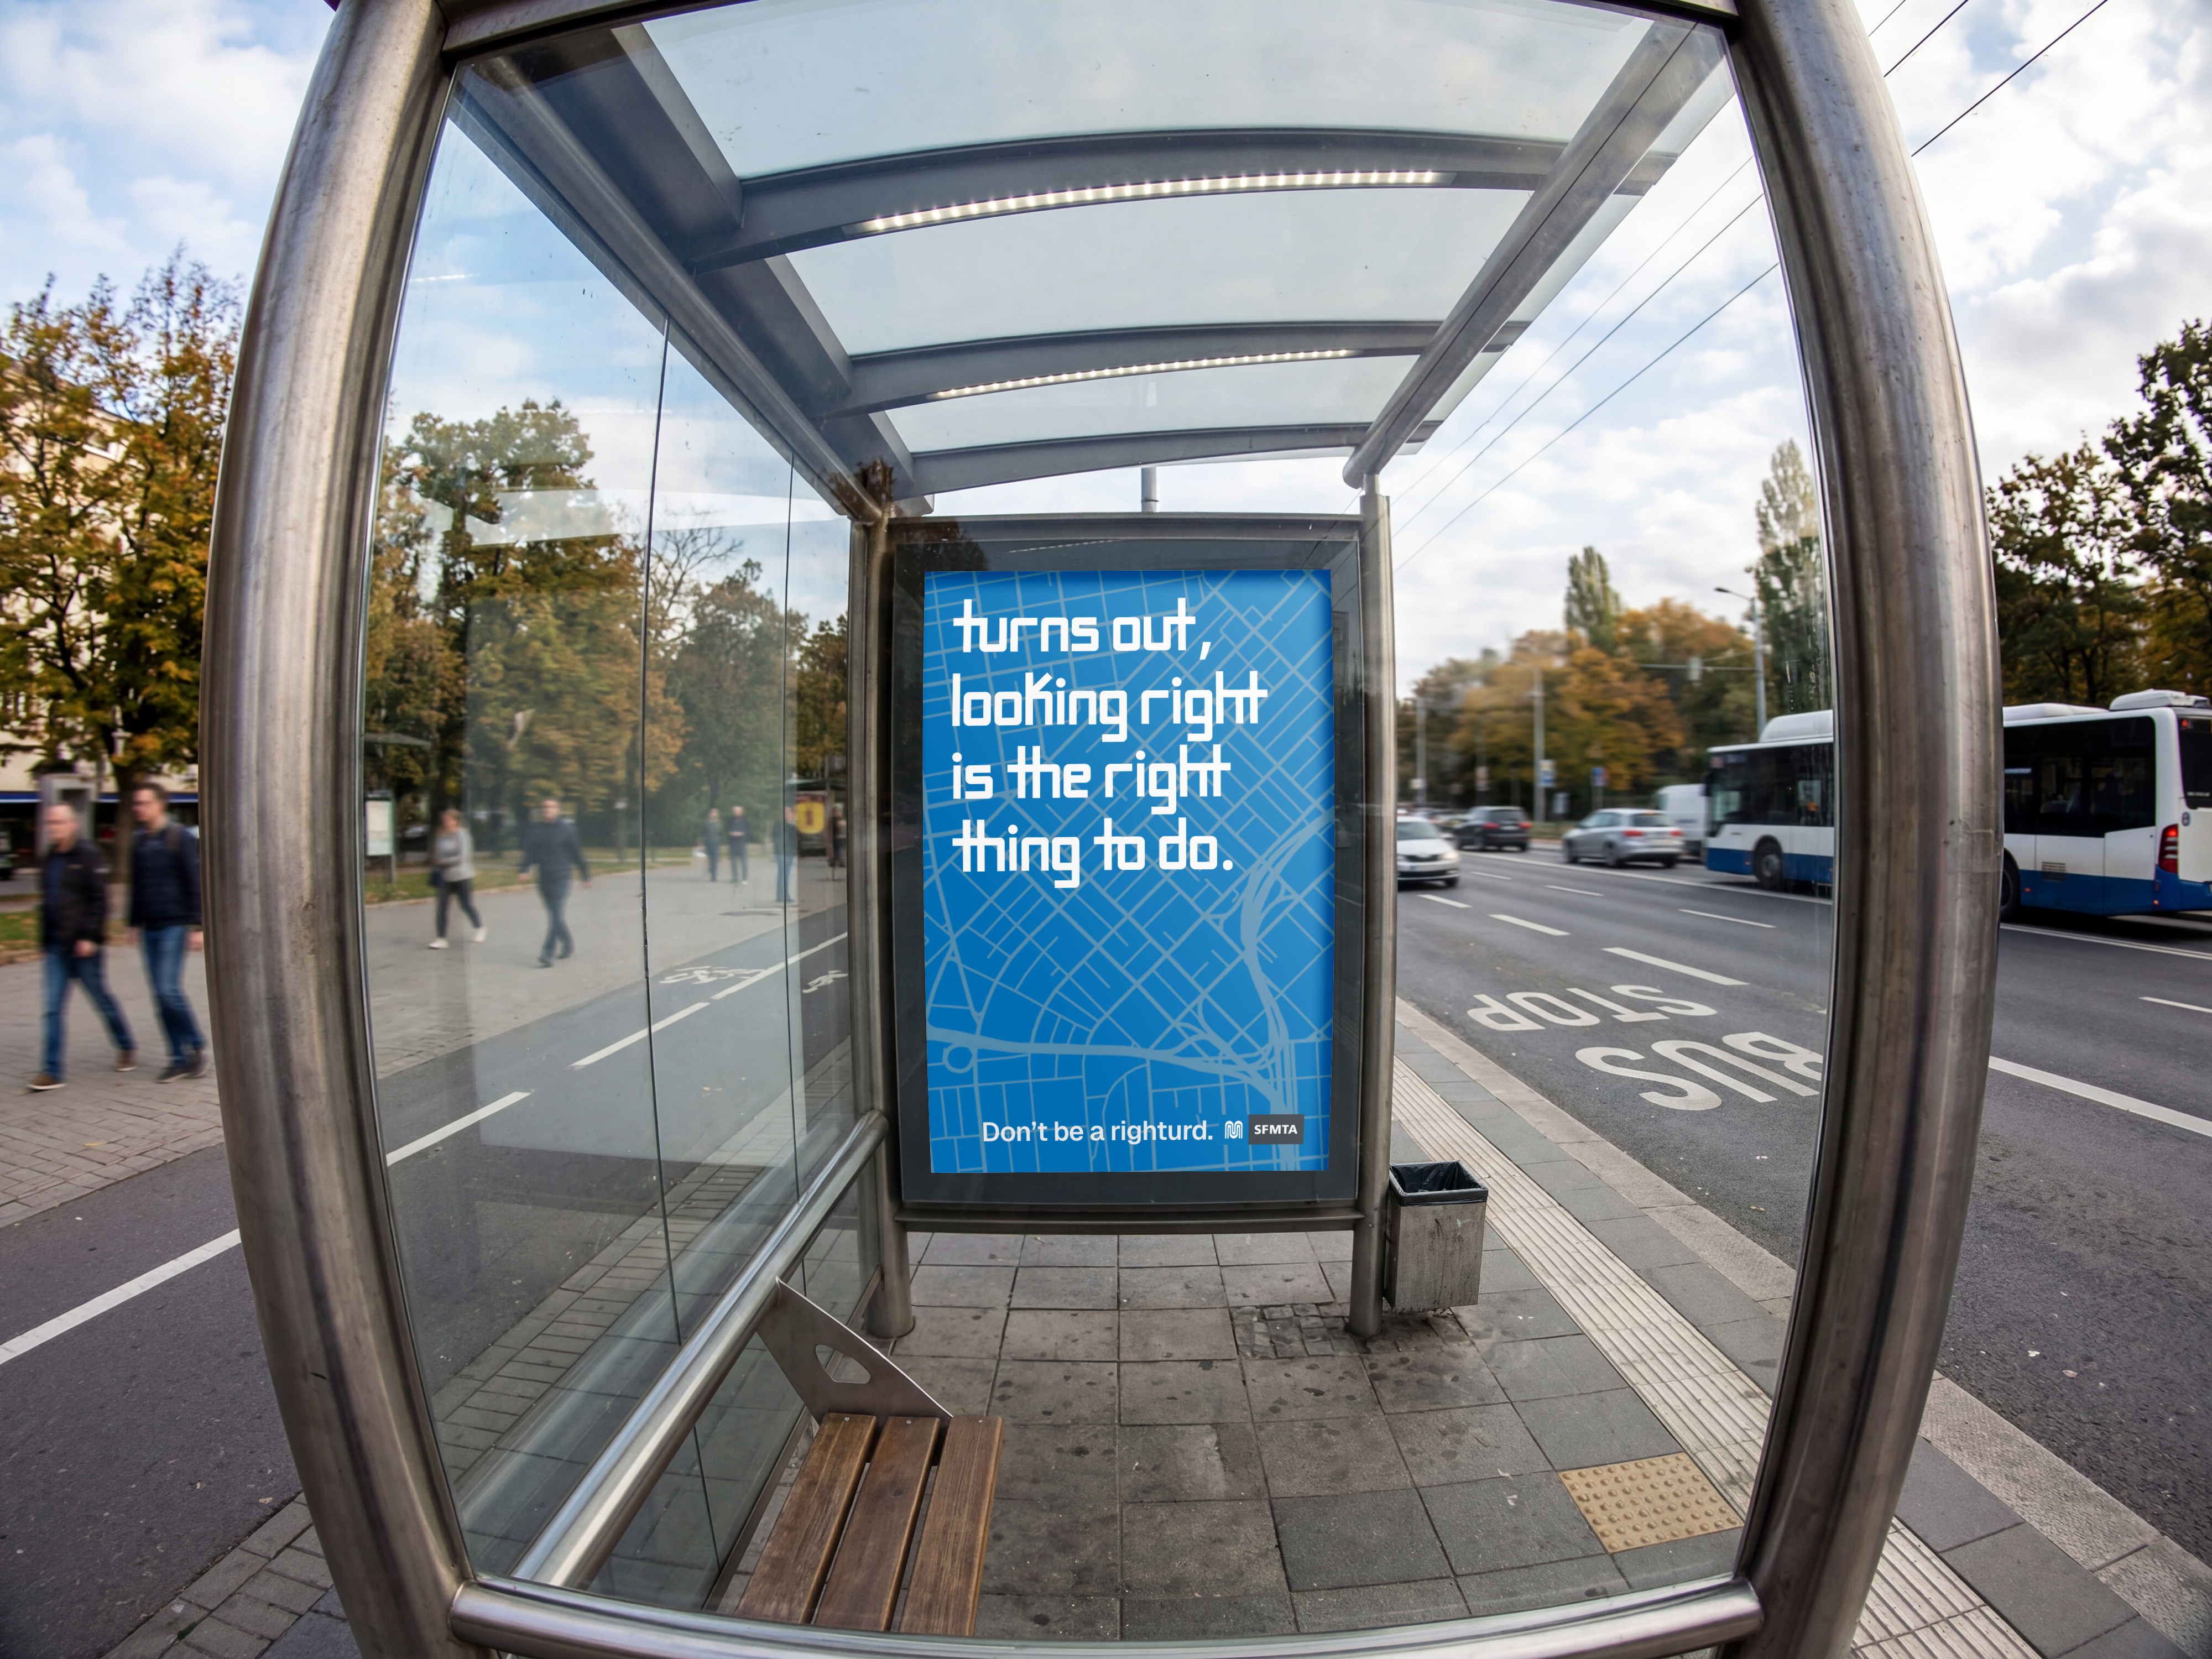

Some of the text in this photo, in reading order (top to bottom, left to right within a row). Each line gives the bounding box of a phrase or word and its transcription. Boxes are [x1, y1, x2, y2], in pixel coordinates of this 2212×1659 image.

[952, 597, 1211, 660] turns out,
[952, 670, 1268, 742] looking right
[952, 744, 1231, 815] is the right
[952, 817, 1234, 889] thing to do.
[1466, 984, 1718, 1032] STOP
[1575, 1031, 1824, 1111] BUS
[982, 1120, 1213, 1145] Don't be a righturd.
[1254, 1124, 1298, 1135] SFMTA
